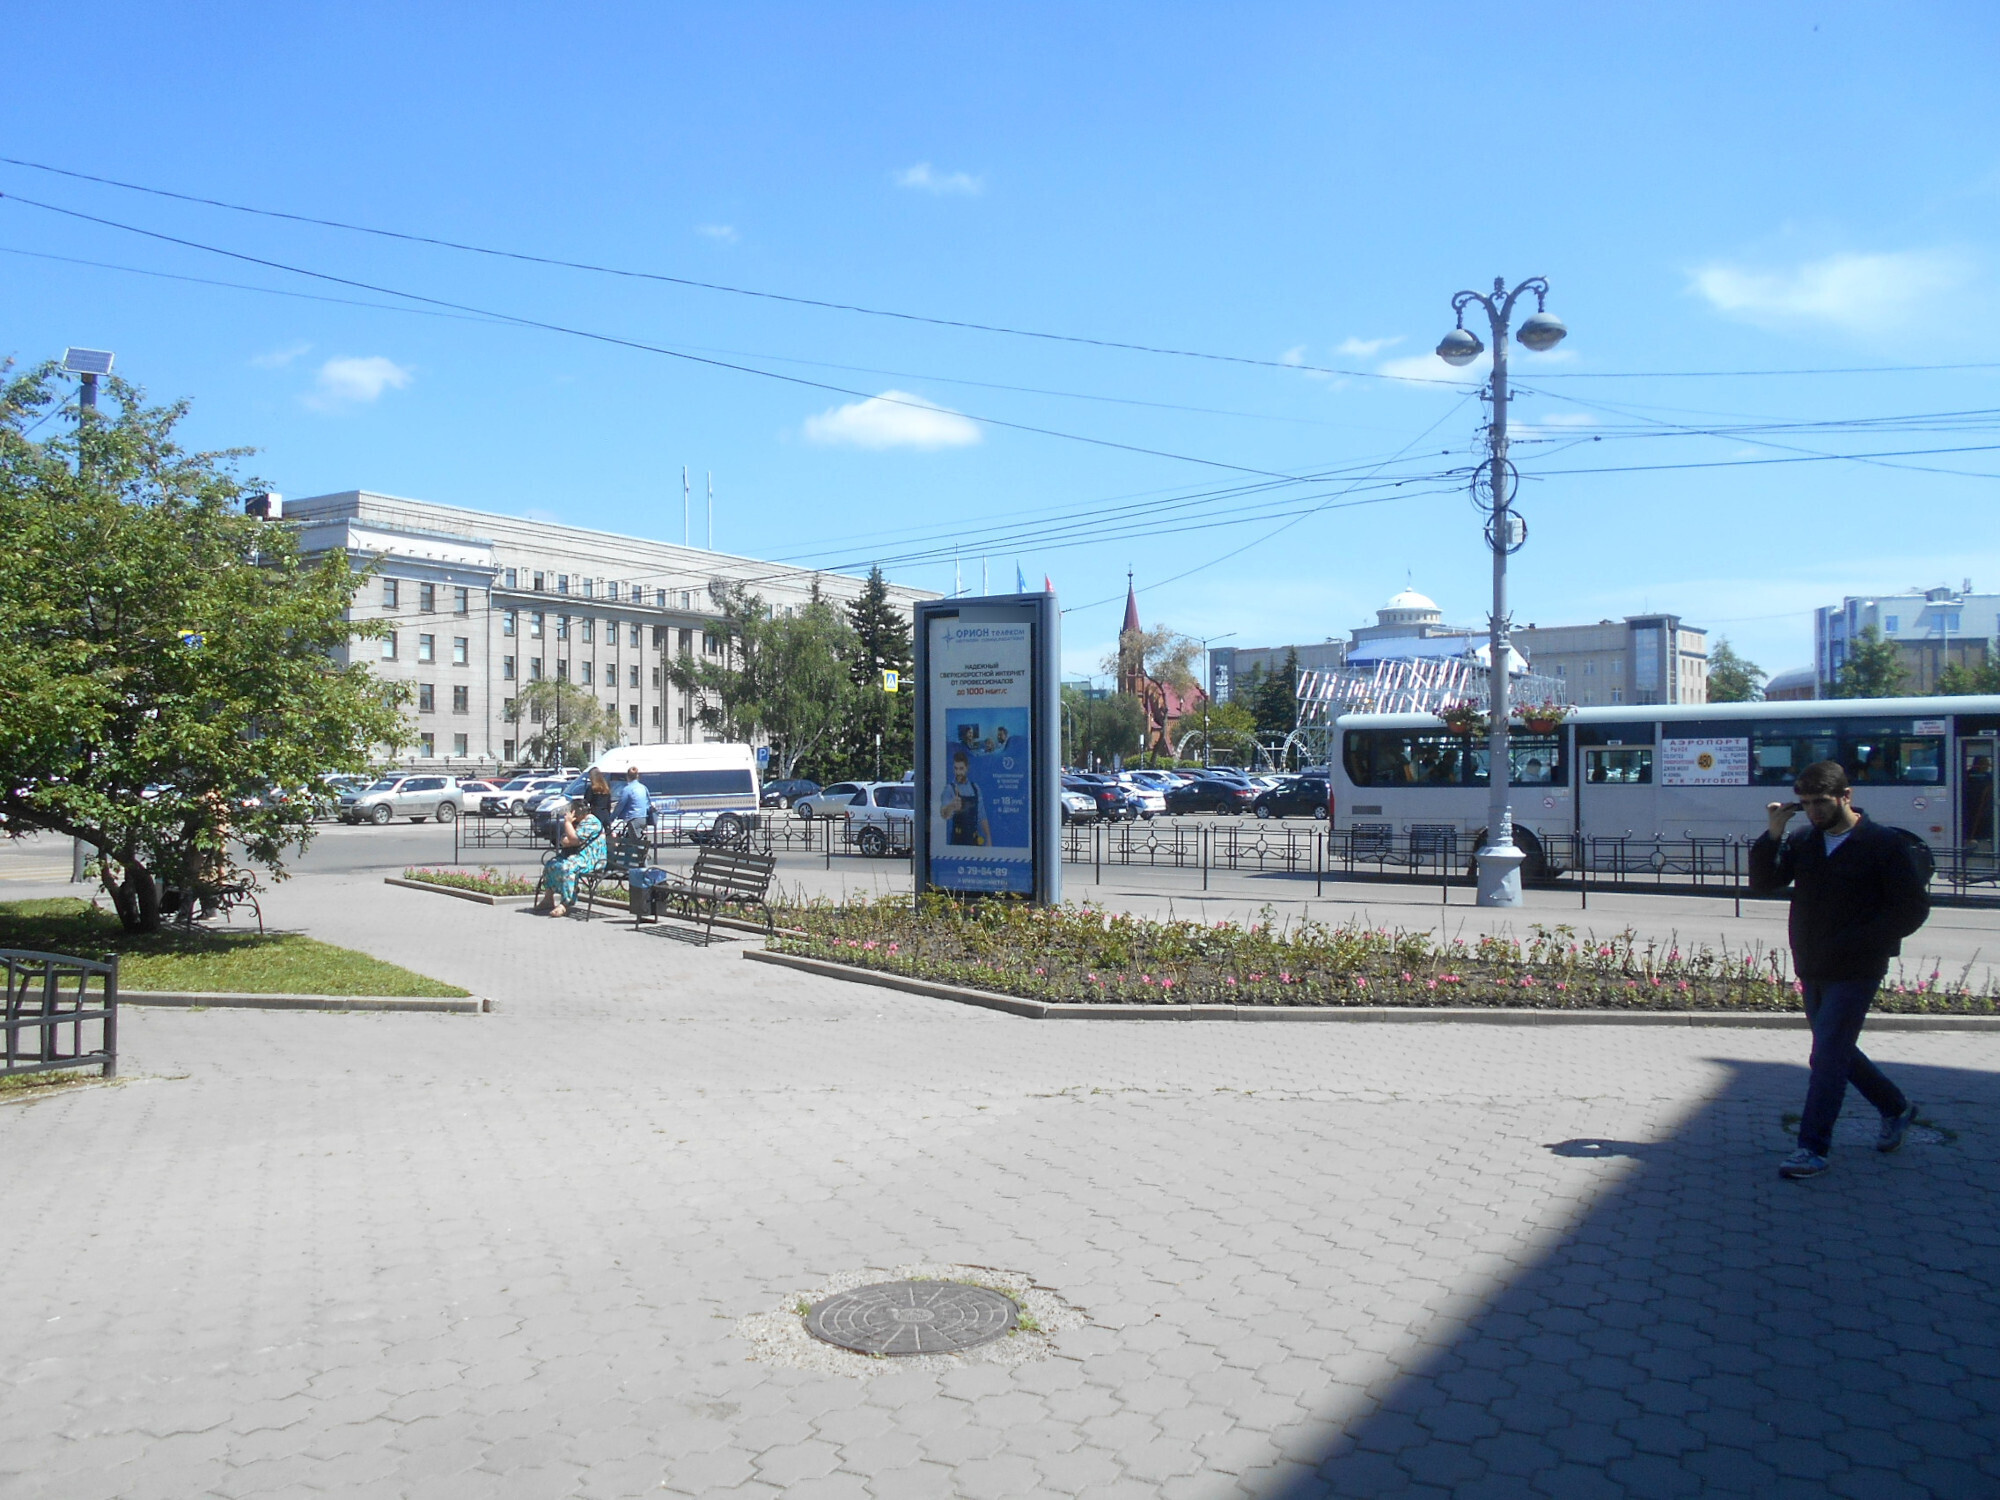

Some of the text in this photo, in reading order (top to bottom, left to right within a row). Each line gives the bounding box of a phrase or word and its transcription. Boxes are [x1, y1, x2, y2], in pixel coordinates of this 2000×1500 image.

[956, 628, 989, 638] ОРИОН
[964, 662, 999, 670] НАДЕЖНЫЙ
[960, 678, 1014, 686] ПРОФЕССИОНАЛОВ
[967, 687, 985, 695] 1000
